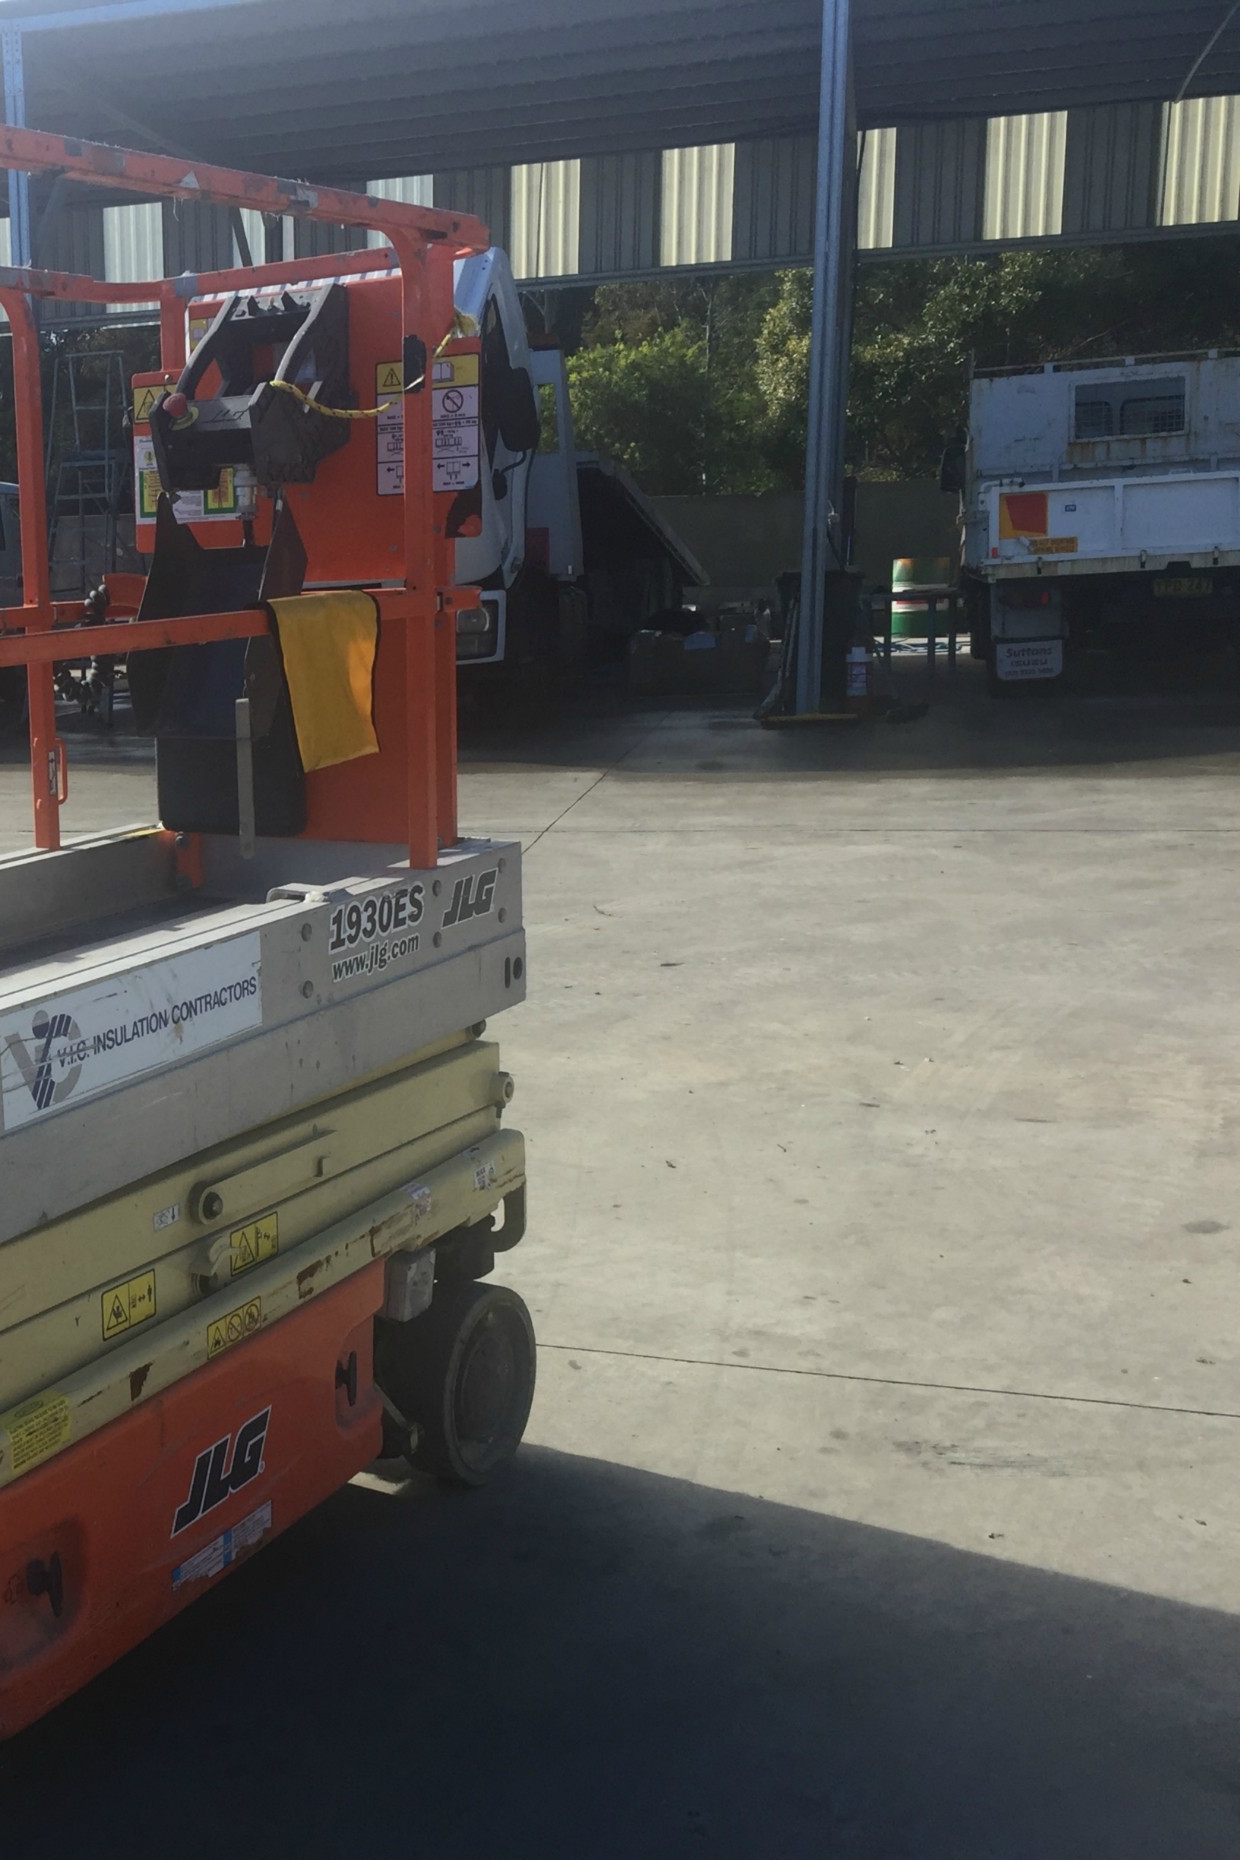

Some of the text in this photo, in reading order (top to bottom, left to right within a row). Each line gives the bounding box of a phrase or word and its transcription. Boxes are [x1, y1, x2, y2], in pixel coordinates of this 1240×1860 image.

[1005, 647, 1053, 658] Suttons
[330, 884, 425, 951] 1930ES
[442, 869, 497, 927] JLG
[332, 933, 420, 980] www.jlg.com
[93, 1008, 169, 1055] INSULATION
[171, 976, 257, 1025] CONTRACTORS
[170, 1404, 272, 1539] JLG
